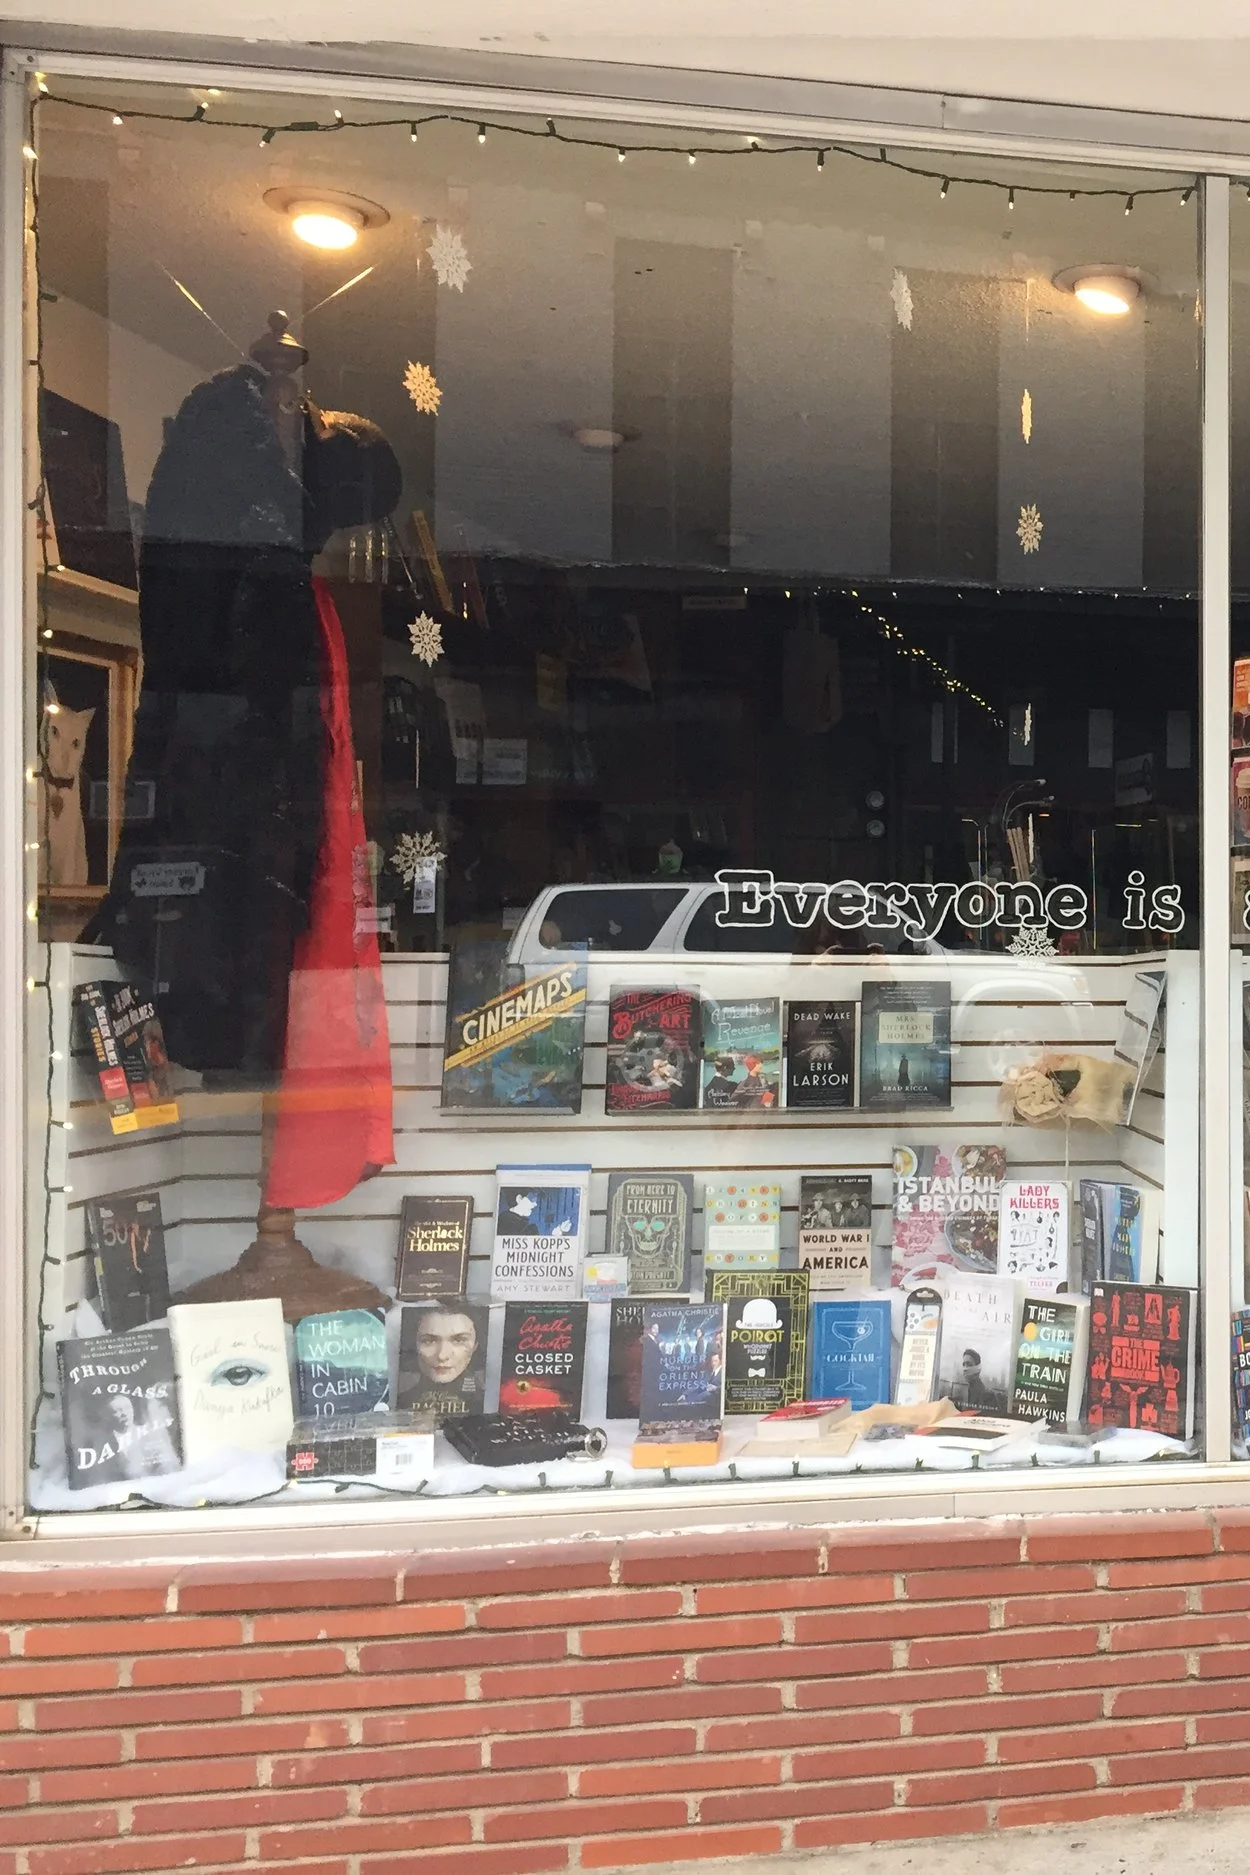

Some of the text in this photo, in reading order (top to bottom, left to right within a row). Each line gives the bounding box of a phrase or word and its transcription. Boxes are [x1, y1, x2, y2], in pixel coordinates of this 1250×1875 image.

[715, 868, 1088, 941] Everyone
[1123, 870, 1185, 932] is
[462, 971, 574, 1046] CINEMAPS
[660, 1013, 692, 1029] ART
[794, 1011, 852, 1022] DEAD WAKE
[717, 1022, 773, 1044] Revenge
[881, 1024, 932, 1033] SHERLOCK
[886, 1033, 926, 1041] HOLMES
[810, 1062, 834, 1072] ERIK
[793, 1074, 849, 1087] LARSON
[882, 1085, 929, 1093] BRAD RICCA
[627, 1185, 646, 1195] FROM
[897, 1176, 1000, 1195] ISTANBUL
[1019, 1185, 1050, 1197] LADY
[626, 1200, 674, 1214] ETERNITY
[897, 1194, 1000, 1213] & BEYOND
[1009, 1198, 1060, 1209] KILLERS
[407, 1226, 464, 1239] Sherlock
[803, 1233, 870, 1243] WORLD WAR I
[409, 1239, 460, 1253] Holmes
[502, 1237, 571, 1250] MISS KOPP'S
[506, 1251, 564, 1264] MIDNIGHT
[802, 1256, 869, 1270] AMERICA
[494, 1265, 575, 1278] CONFESSIONS
[496, 1284, 571, 1293] AMY STEWART
[943, 1289, 998, 1305] DEATH
[651, 1308, 720, 1318] AGATHA CHRISTIE
[982, 1311, 1012, 1325] AIR
[1027, 1305, 1056, 1323] THE
[307, 1320, 344, 1336] THE
[520, 1315, 574, 1335] Agatha
[518, 1333, 571, 1351] Christie
[730, 1330, 785, 1343] POIROT
[1039, 1327, 1073, 1343] GIRL
[308, 1335, 386, 1359] WOMAN
[1019, 1342, 1073, 1365] ON THE
[515, 1352, 574, 1363] CLOSED
[1111, 1346, 1160, 1371] CRIME
[69, 1358, 149, 1384] THROUGH
[311, 1363, 331, 1379] IN
[515, 1365, 573, 1375] CASKET
[659, 1371, 706, 1382] ORIENT
[1021, 1363, 1068, 1385] TRAIN
[92, 1383, 169, 1399] A GLASS
[312, 1377, 368, 1400] CABIN
[658, 1381, 708, 1391] EXPRESS
[1015, 1388, 1048, 1404] PAULA
[313, 1402, 335, 1419] 10
[1018, 1404, 1067, 1423] HAWKINS
